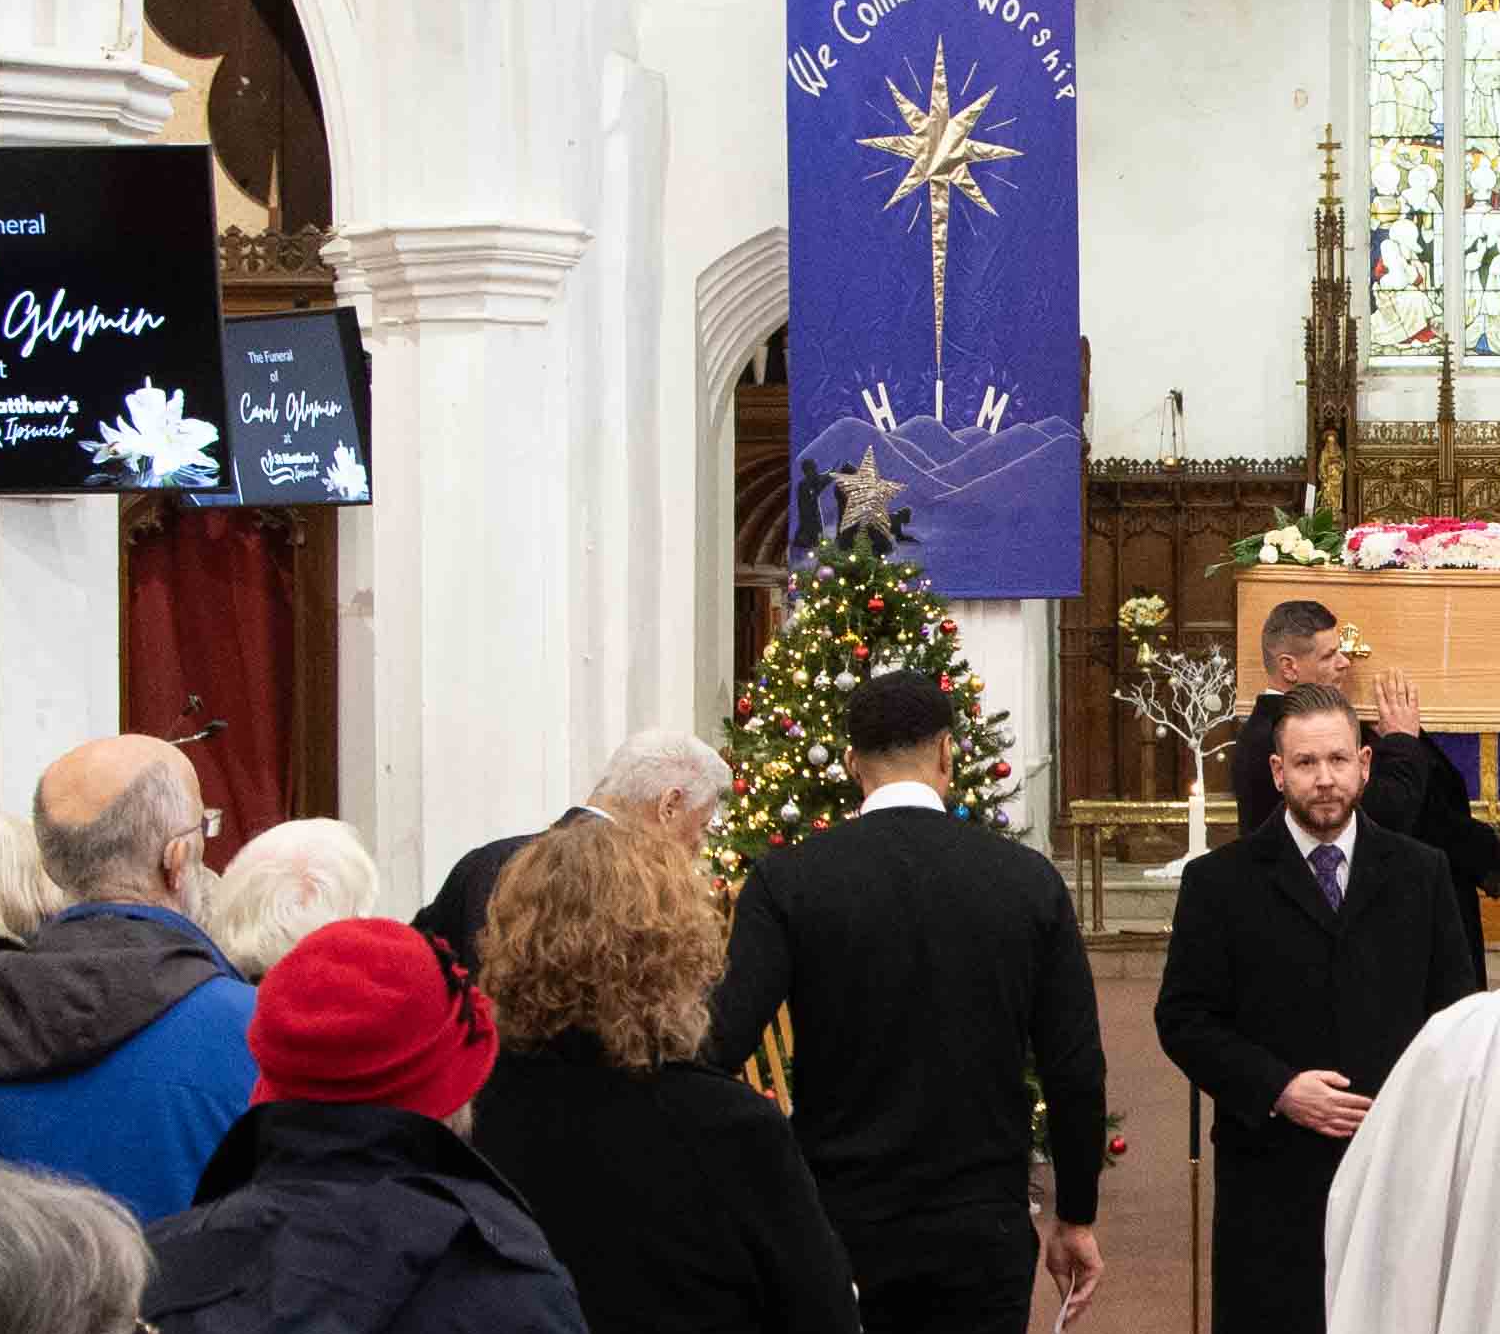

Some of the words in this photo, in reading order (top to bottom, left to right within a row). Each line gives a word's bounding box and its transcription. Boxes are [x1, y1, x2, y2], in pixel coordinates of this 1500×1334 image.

[787, 44, 838, 98] We
[247, 350, 263, 364] The
[263, 348, 293, 364] Funeral
[269, 369, 279, 383] of
[240, 391, 279, 425] Carol
[3, 415, 75, 446] Ipswich
